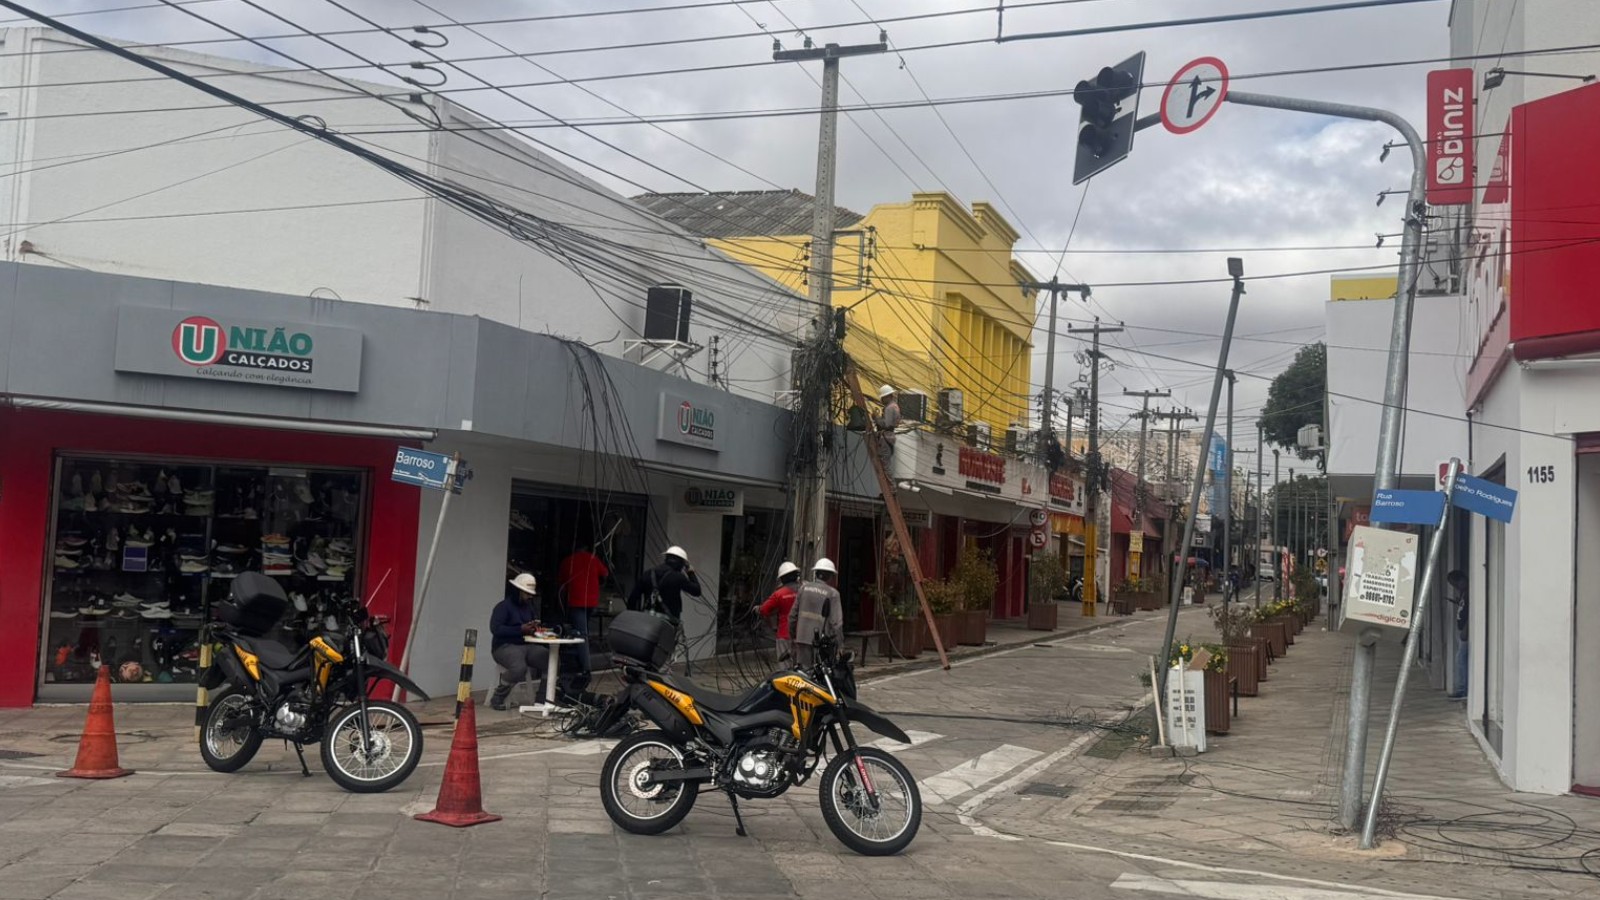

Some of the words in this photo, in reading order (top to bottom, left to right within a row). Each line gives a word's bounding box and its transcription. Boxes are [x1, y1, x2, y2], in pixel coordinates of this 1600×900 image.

[228, 353, 311, 371] CALÇADOS
[196, 367, 243, 380] Calçando
[245, 373, 266, 381] com
[266, 374, 313, 385] elegância
[396, 451, 435, 470] Barroso
[1527, 465, 1555, 484] 1155
[1455, 484, 1475, 495] oelho
[1476, 489, 1513, 507] Rodrigues
